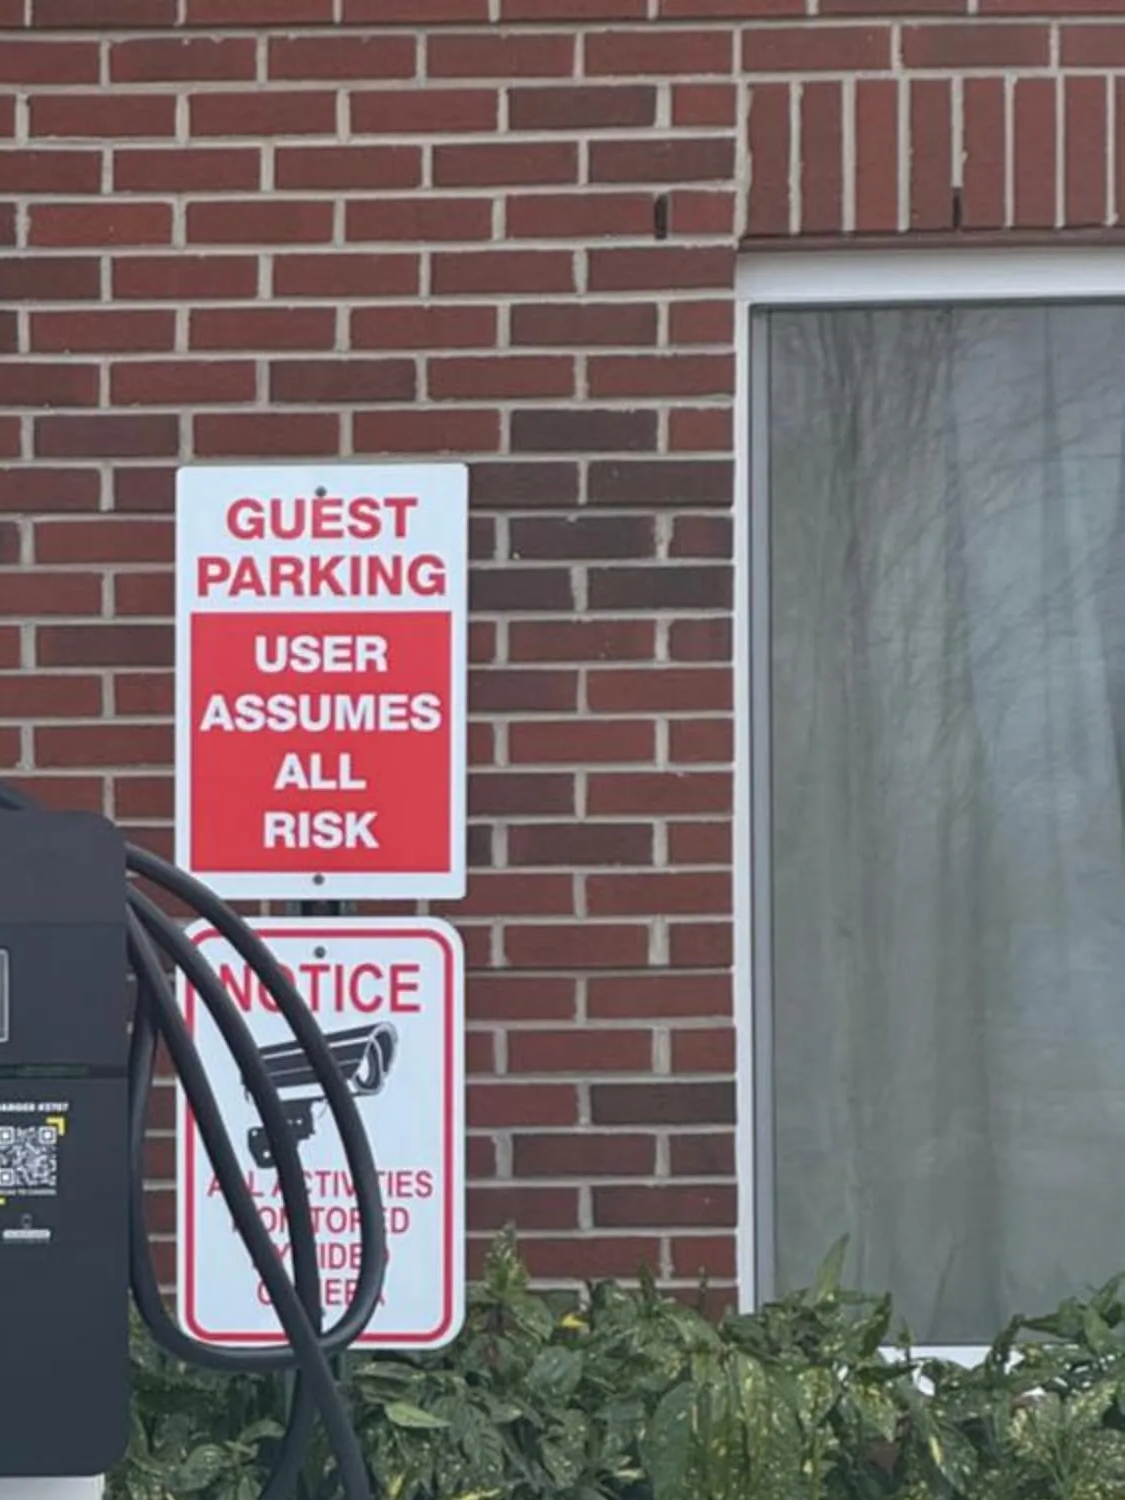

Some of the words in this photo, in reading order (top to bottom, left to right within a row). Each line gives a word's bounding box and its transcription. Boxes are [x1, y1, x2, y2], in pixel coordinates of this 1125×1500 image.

[225, 497, 418, 541] GUEST
[196, 554, 447, 597] PARKING
[254, 635, 389, 672] USER
[199, 694, 442, 732] ASSUMES
[273, 753, 367, 790] ALL
[263, 811, 380, 849] RISK
